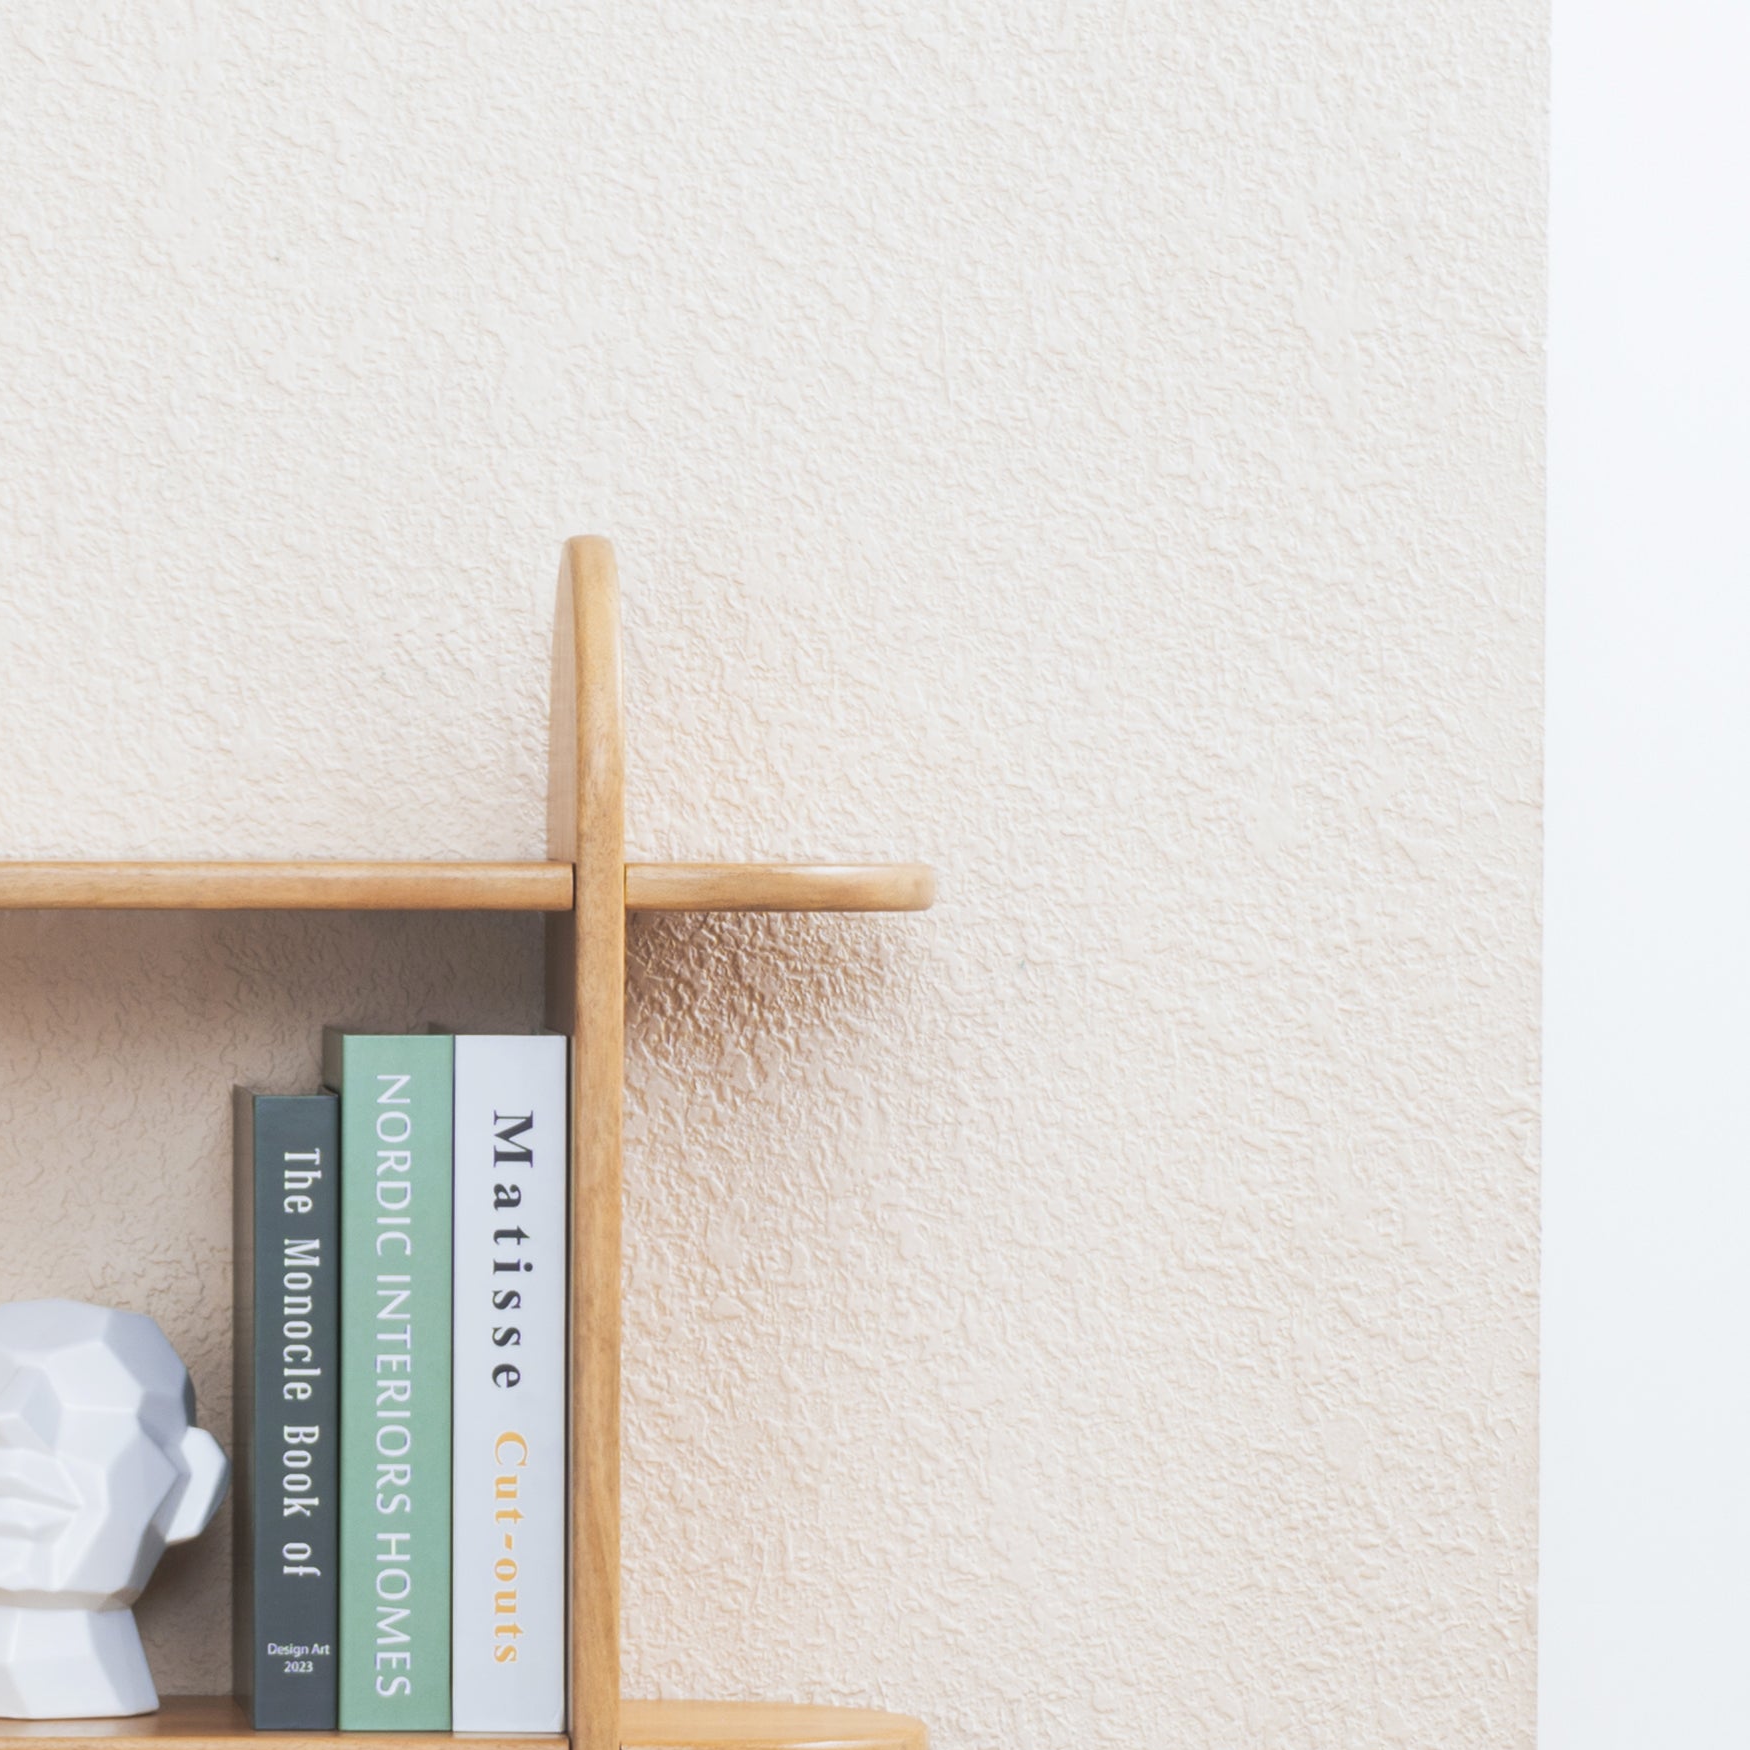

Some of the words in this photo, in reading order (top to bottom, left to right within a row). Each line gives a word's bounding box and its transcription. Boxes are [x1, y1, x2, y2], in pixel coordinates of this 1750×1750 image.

[284, 1148, 322, 1213] The
[377, 1076, 410, 1254] NORDIC
[283, 1239, 321, 1400] Monocle
[492, 1111, 533, 1388] Matisse
[283, 1426, 319, 1516] Book
[377, 1276, 410, 1513] INTERIORS
[283, 1543, 321, 1576] of
[376, 1534, 410, 1696] HOMES
[495, 1432, 527, 1662] Cut-outs
[268, 1643, 308, 1657] Design
[312, 1644, 329, 1654] Art
[285, 1661, 313, 1672] 2023
